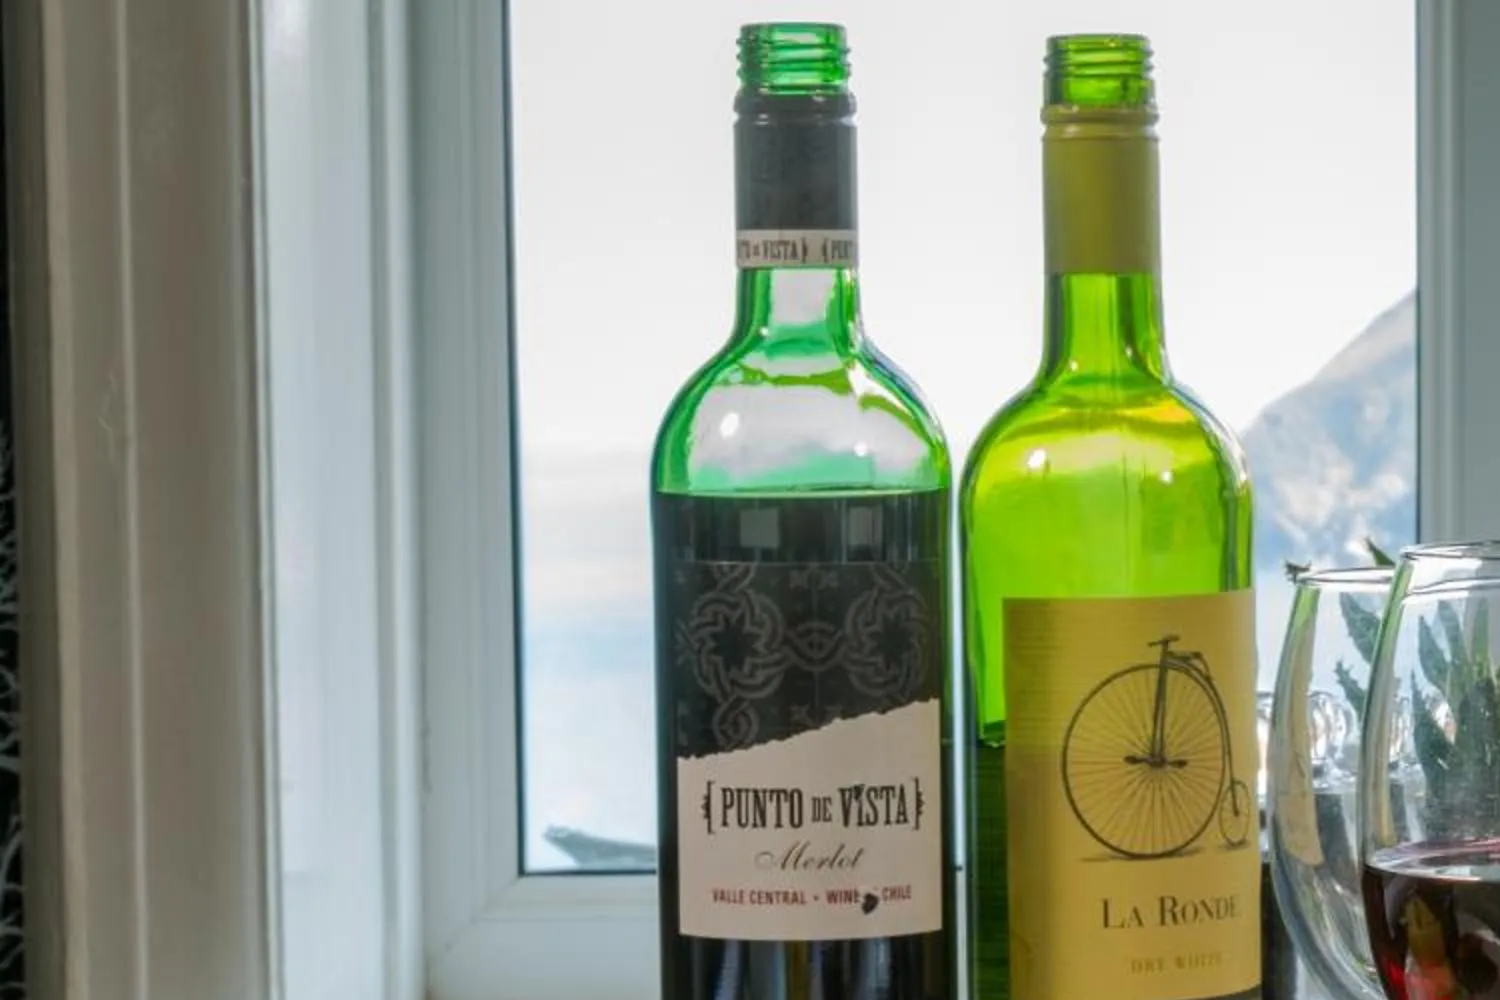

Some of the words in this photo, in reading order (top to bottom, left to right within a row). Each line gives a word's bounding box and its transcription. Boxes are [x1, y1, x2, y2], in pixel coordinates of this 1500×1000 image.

[720, 787, 804, 829] PUNTO
[811, 796, 833, 823] DE
[838, 783, 910, 828] VISTA
[754, 840, 865, 870] Merlot
[712, 887, 745, 904] VALLE
[749, 888, 807, 905] CENTRAL
[881, 884, 912, 900] CHILE
